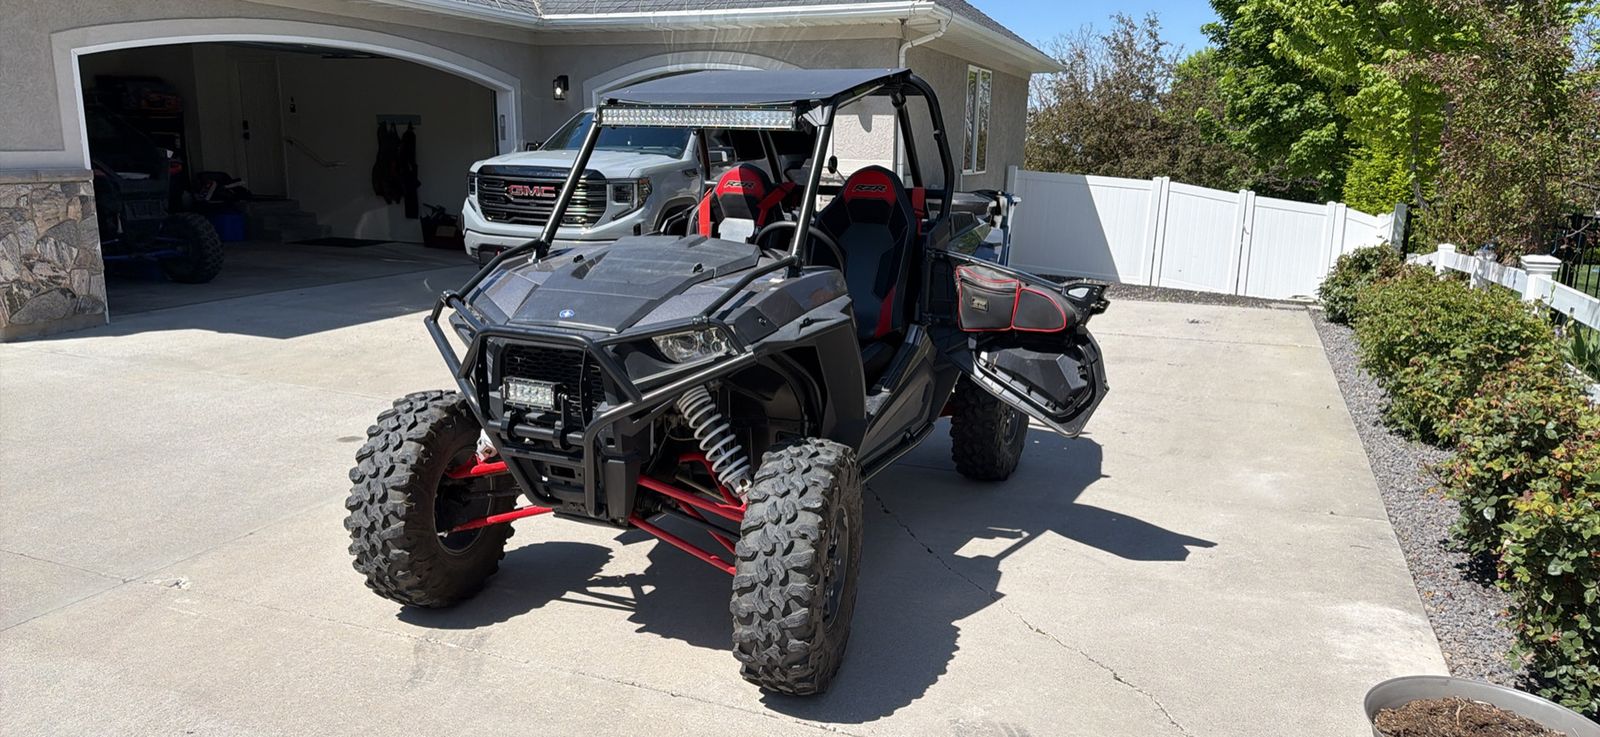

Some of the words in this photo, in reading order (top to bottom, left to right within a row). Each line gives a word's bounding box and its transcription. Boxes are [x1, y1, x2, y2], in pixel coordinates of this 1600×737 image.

[724, 180, 755, 189] RZR
[852, 184, 887, 192] RZR
[508, 184, 556, 198] GMC
